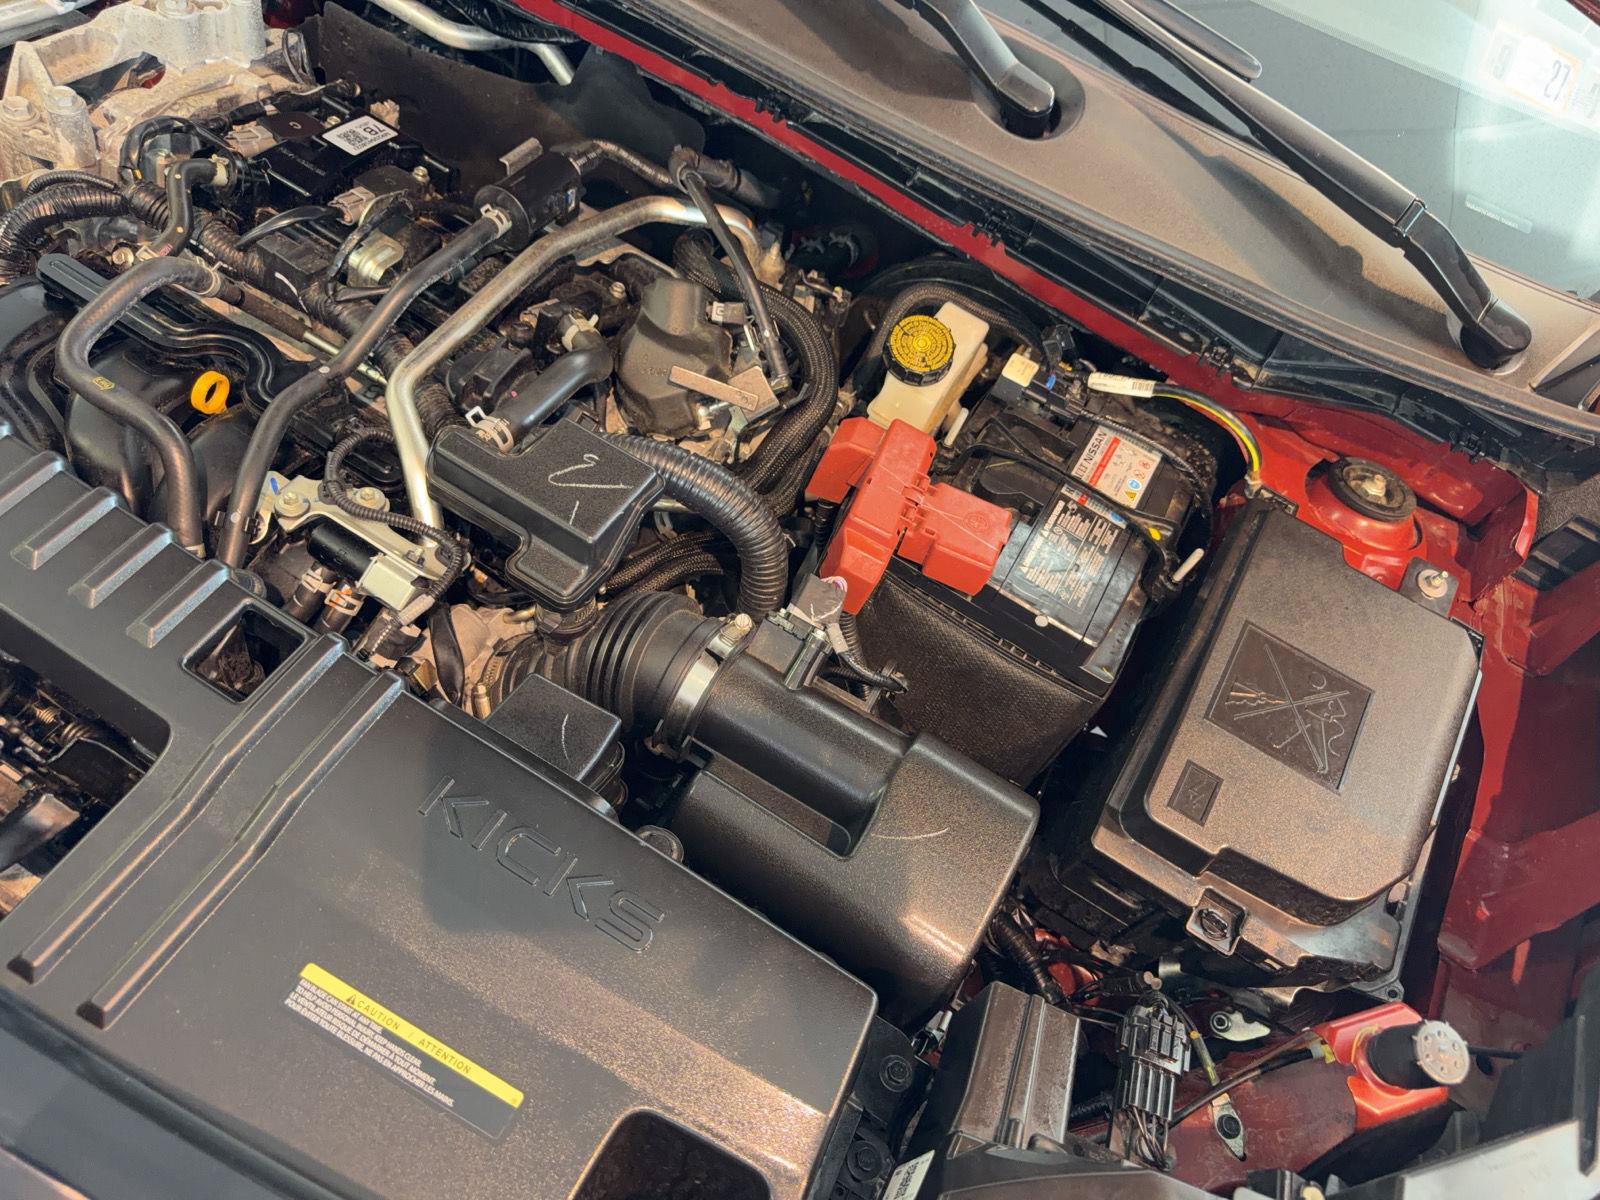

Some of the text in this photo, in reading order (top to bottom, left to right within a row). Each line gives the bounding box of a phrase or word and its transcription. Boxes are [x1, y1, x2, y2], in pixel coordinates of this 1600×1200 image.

[1543, 59, 1571, 102] 27
[1081, 430, 1108, 464] NISSAN
[418, 775, 665, 953] KICKS
[356, 999, 401, 1031] CAUTION
[417, 1037, 472, 1075] ATTENTION
